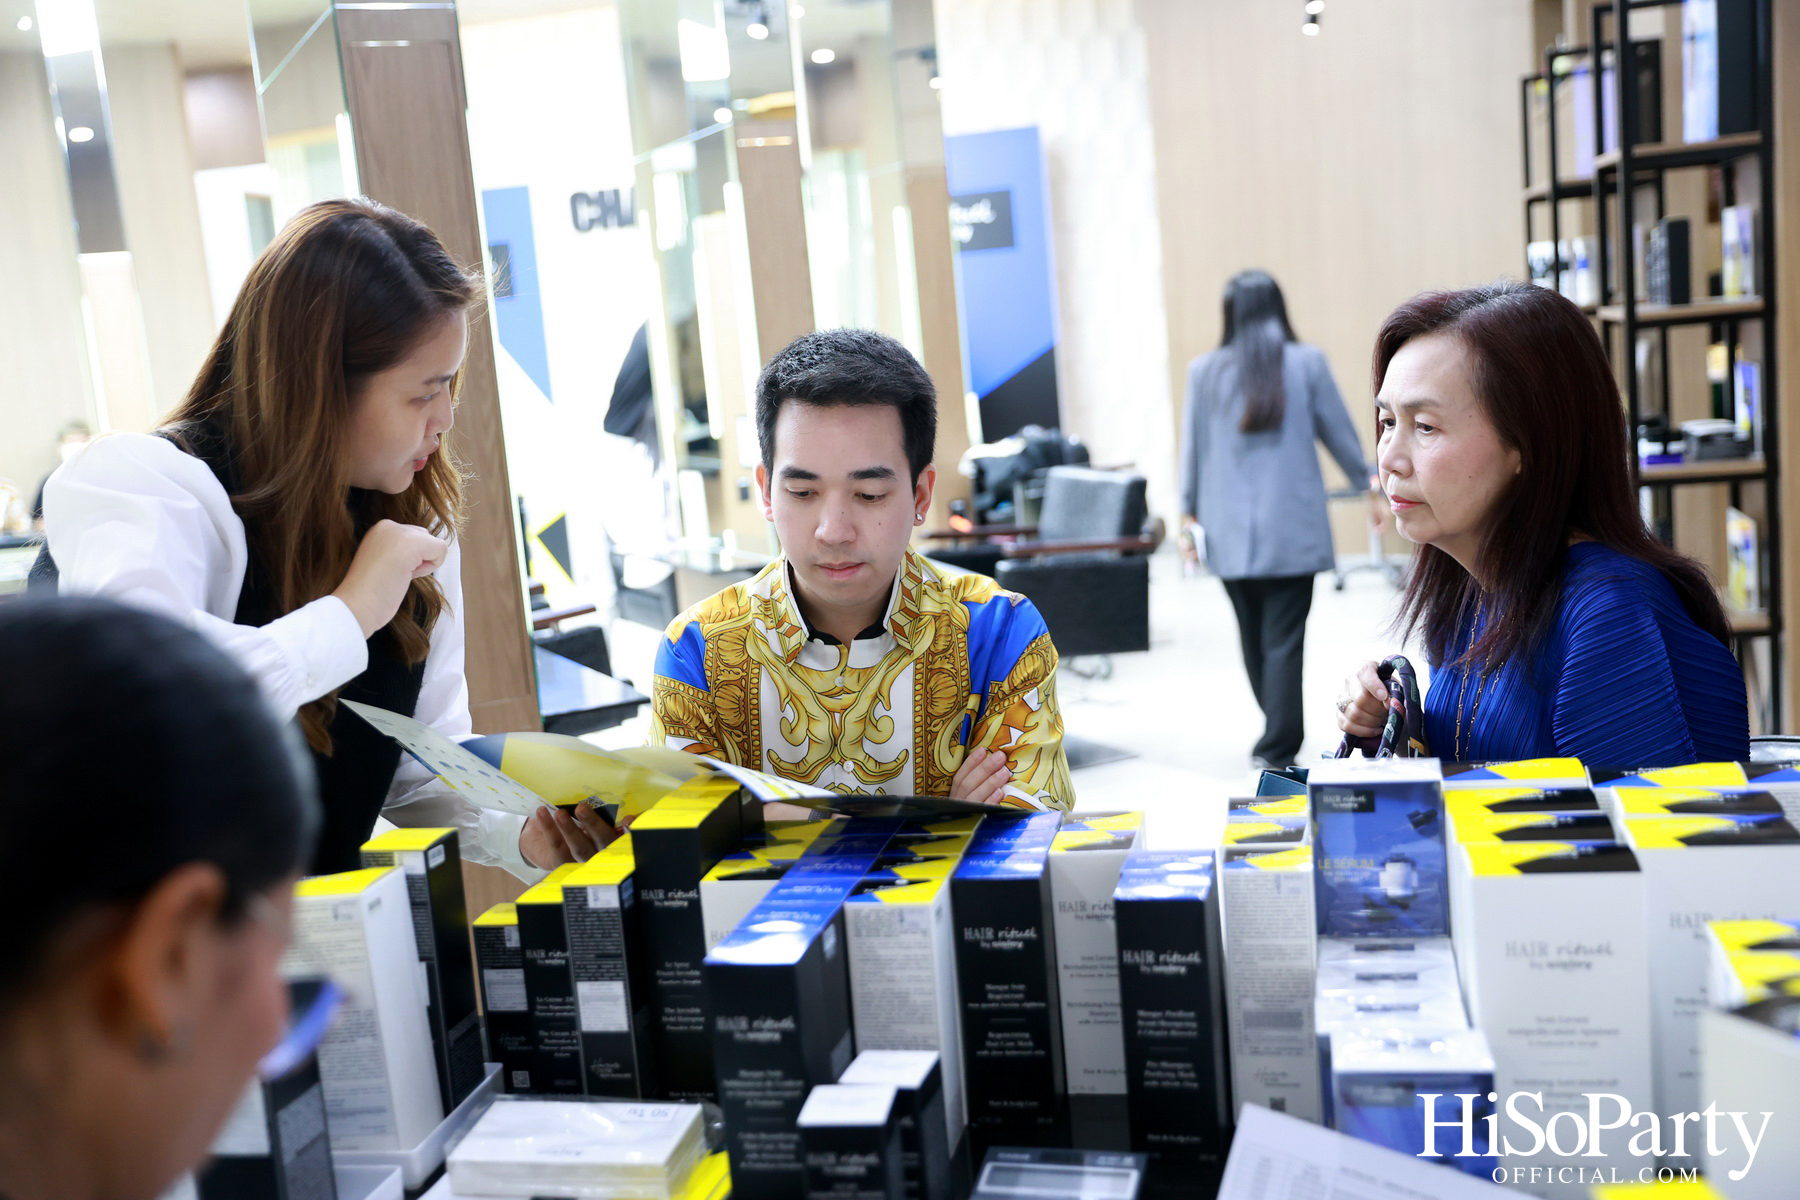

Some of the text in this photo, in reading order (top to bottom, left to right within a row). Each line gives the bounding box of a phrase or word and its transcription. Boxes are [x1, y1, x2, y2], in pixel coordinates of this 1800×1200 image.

[1318, 858, 1332, 869] LE
[641, 889, 699, 900] HAIR rituel
[1058, 901, 1114, 912] HAIR ritu
[964, 927, 1038, 940] HAIR rituel
[526, 949, 546, 958] HAIR
[1506, 942, 1549, 957] HAIR
[1123, 950, 1201, 964] HAIR rituel
